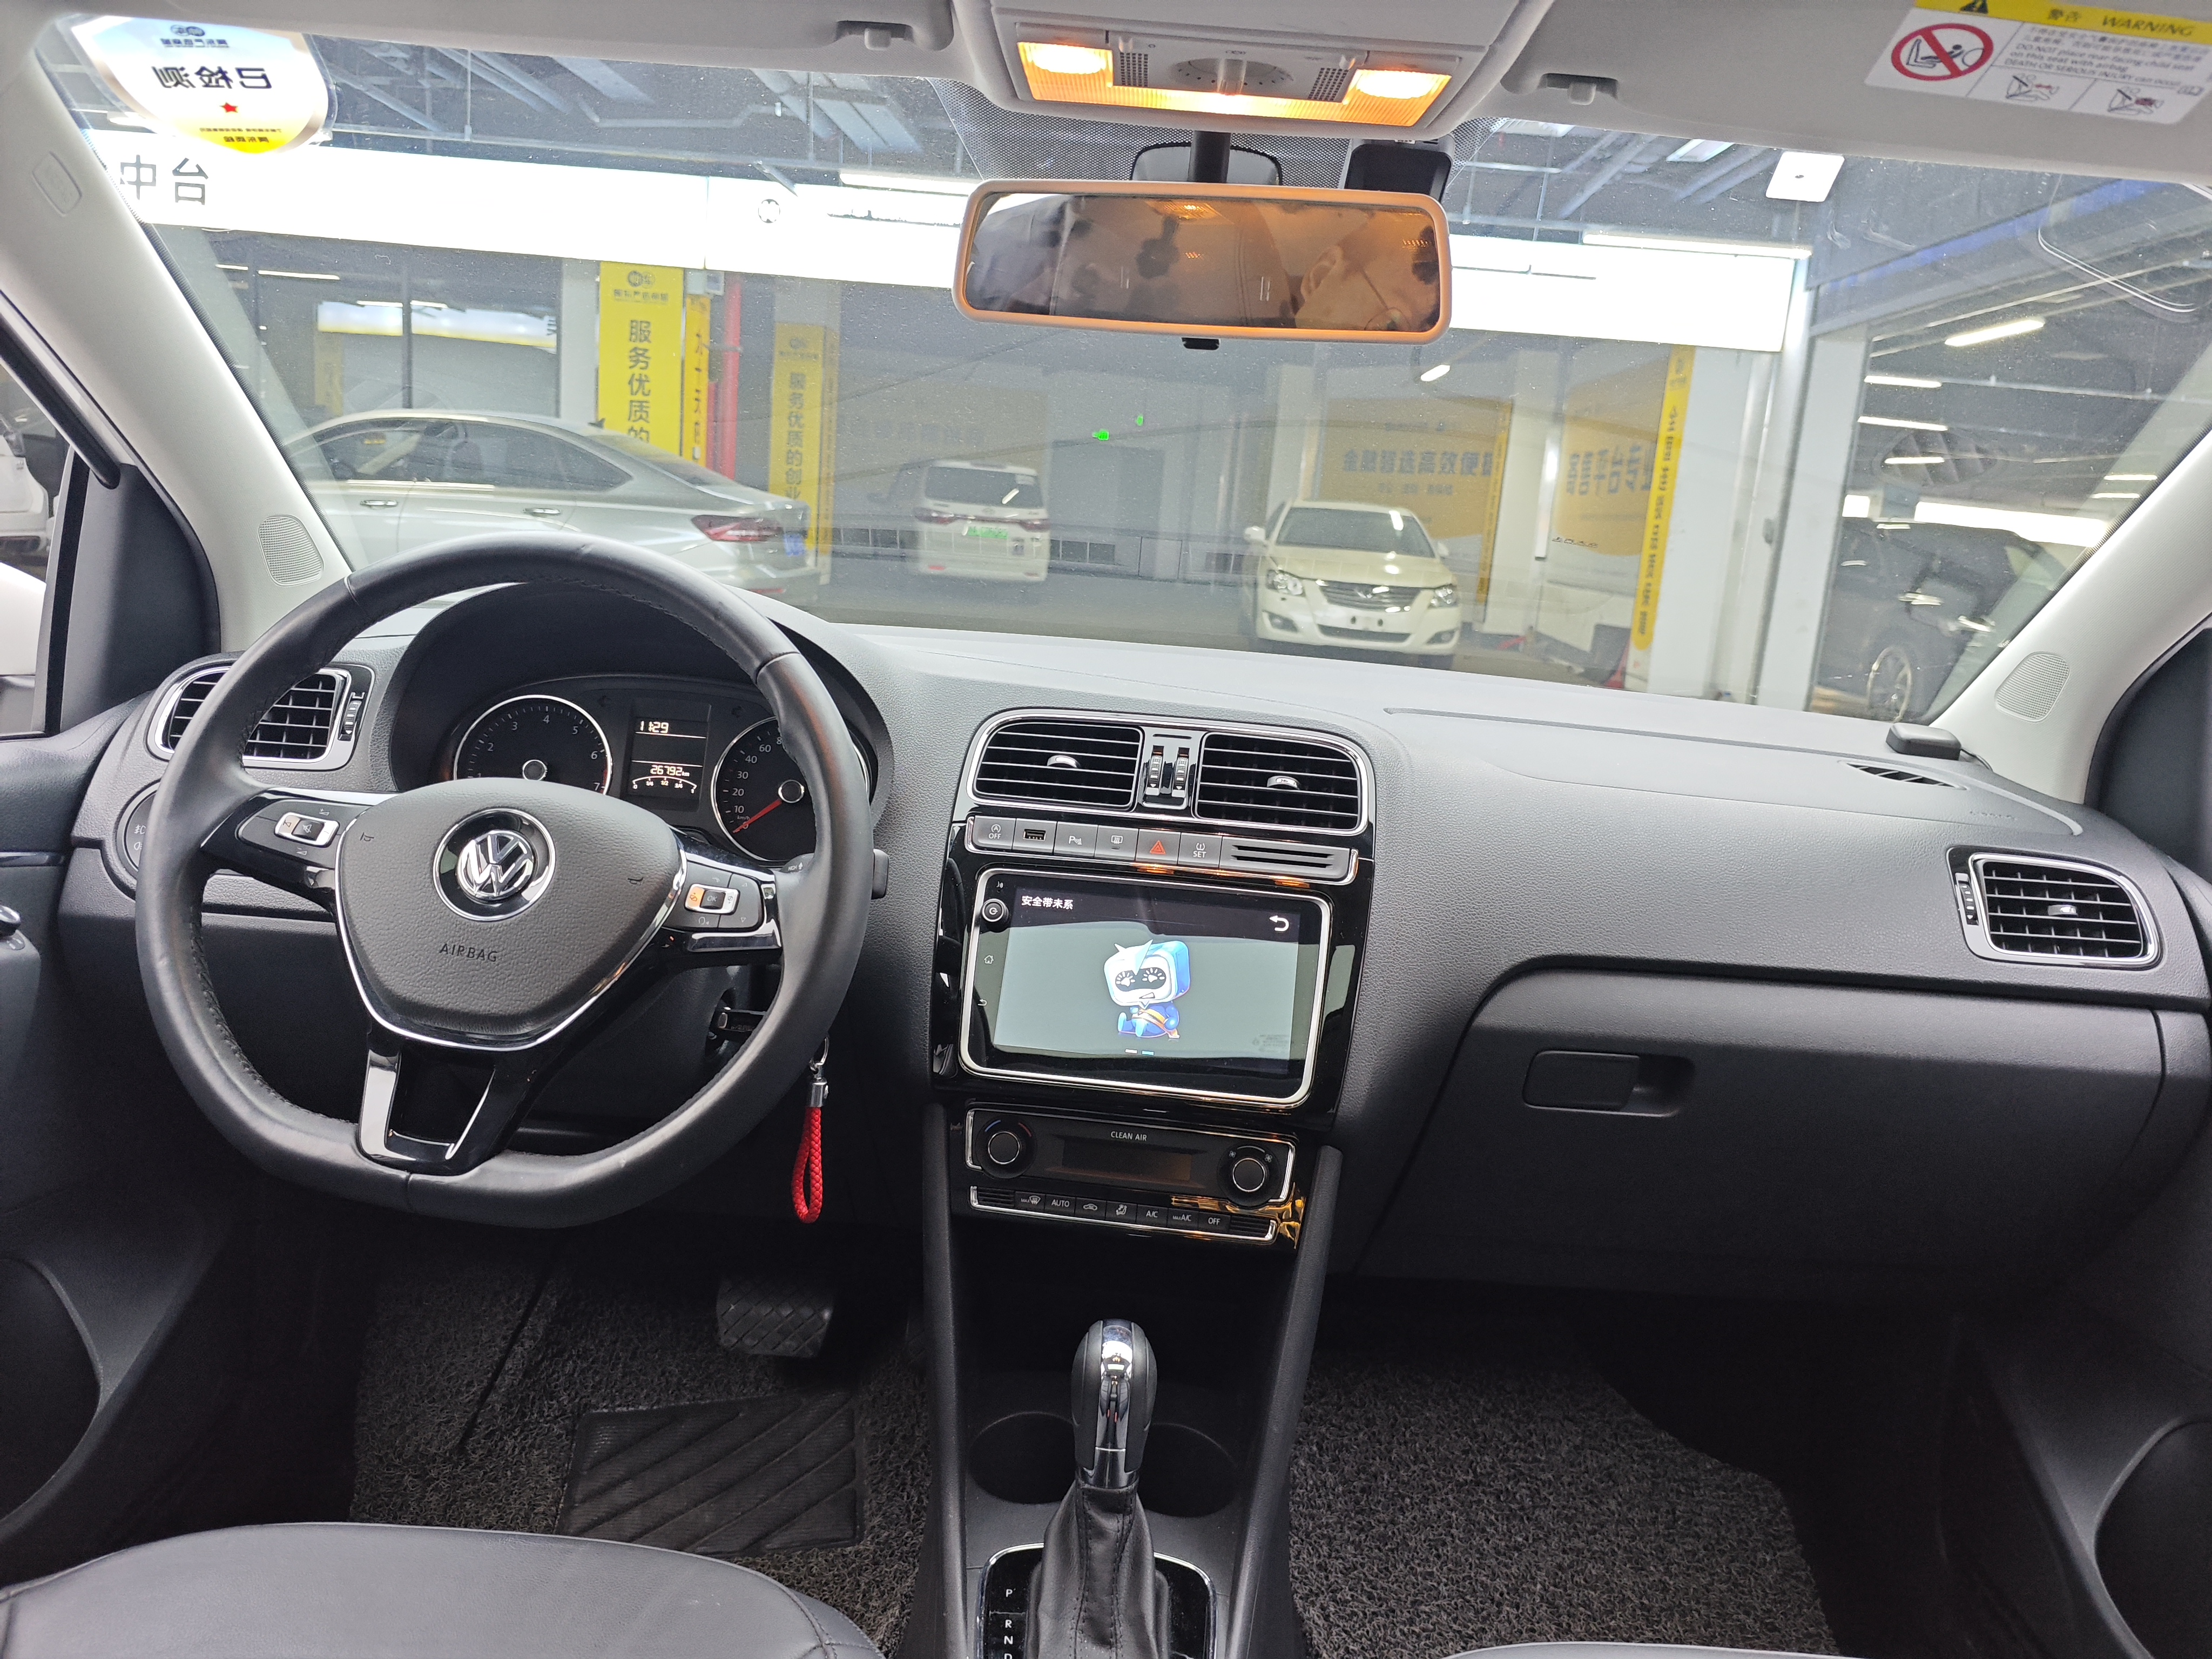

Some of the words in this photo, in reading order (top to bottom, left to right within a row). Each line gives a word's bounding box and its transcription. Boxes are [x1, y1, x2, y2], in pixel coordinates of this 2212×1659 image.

[2102, 15, 2196, 36] WARNING
[120, 154, 208, 205] 中台
[628, 320, 651, 443] 服务优质的
[543, 714, 550, 724] 4
[512, 721, 518, 731] 3
[572, 726, 578, 735] 5
[640, 721, 669, 733] 11:29
[776, 737, 782, 745] 8
[488, 743, 494, 752] 2
[759, 744, 771, 753] 60
[591, 751, 598, 759] 6
[745, 755, 758, 764] 40
[737, 771, 748, 779] 30
[594, 783, 601, 791] 7
[732, 788, 744, 797] 20
[734, 805, 744, 813] 10
[1021, 895, 1074, 911] 安全带未系
[439, 943, 497, 962] AIRBAG
[1111, 1131, 1132, 1139] CLEAN
[1135, 1134, 1147, 1142] AIR
[1051, 1199, 1070, 1208] AUTO
[1146, 1210, 1158, 1219] A/C
[1208, 1217, 1220, 1225] OFF
[1006, 1589, 1013, 1597] P
[1005, 1620, 1012, 1628] R
[1004, 1635, 1013, 1645] N
